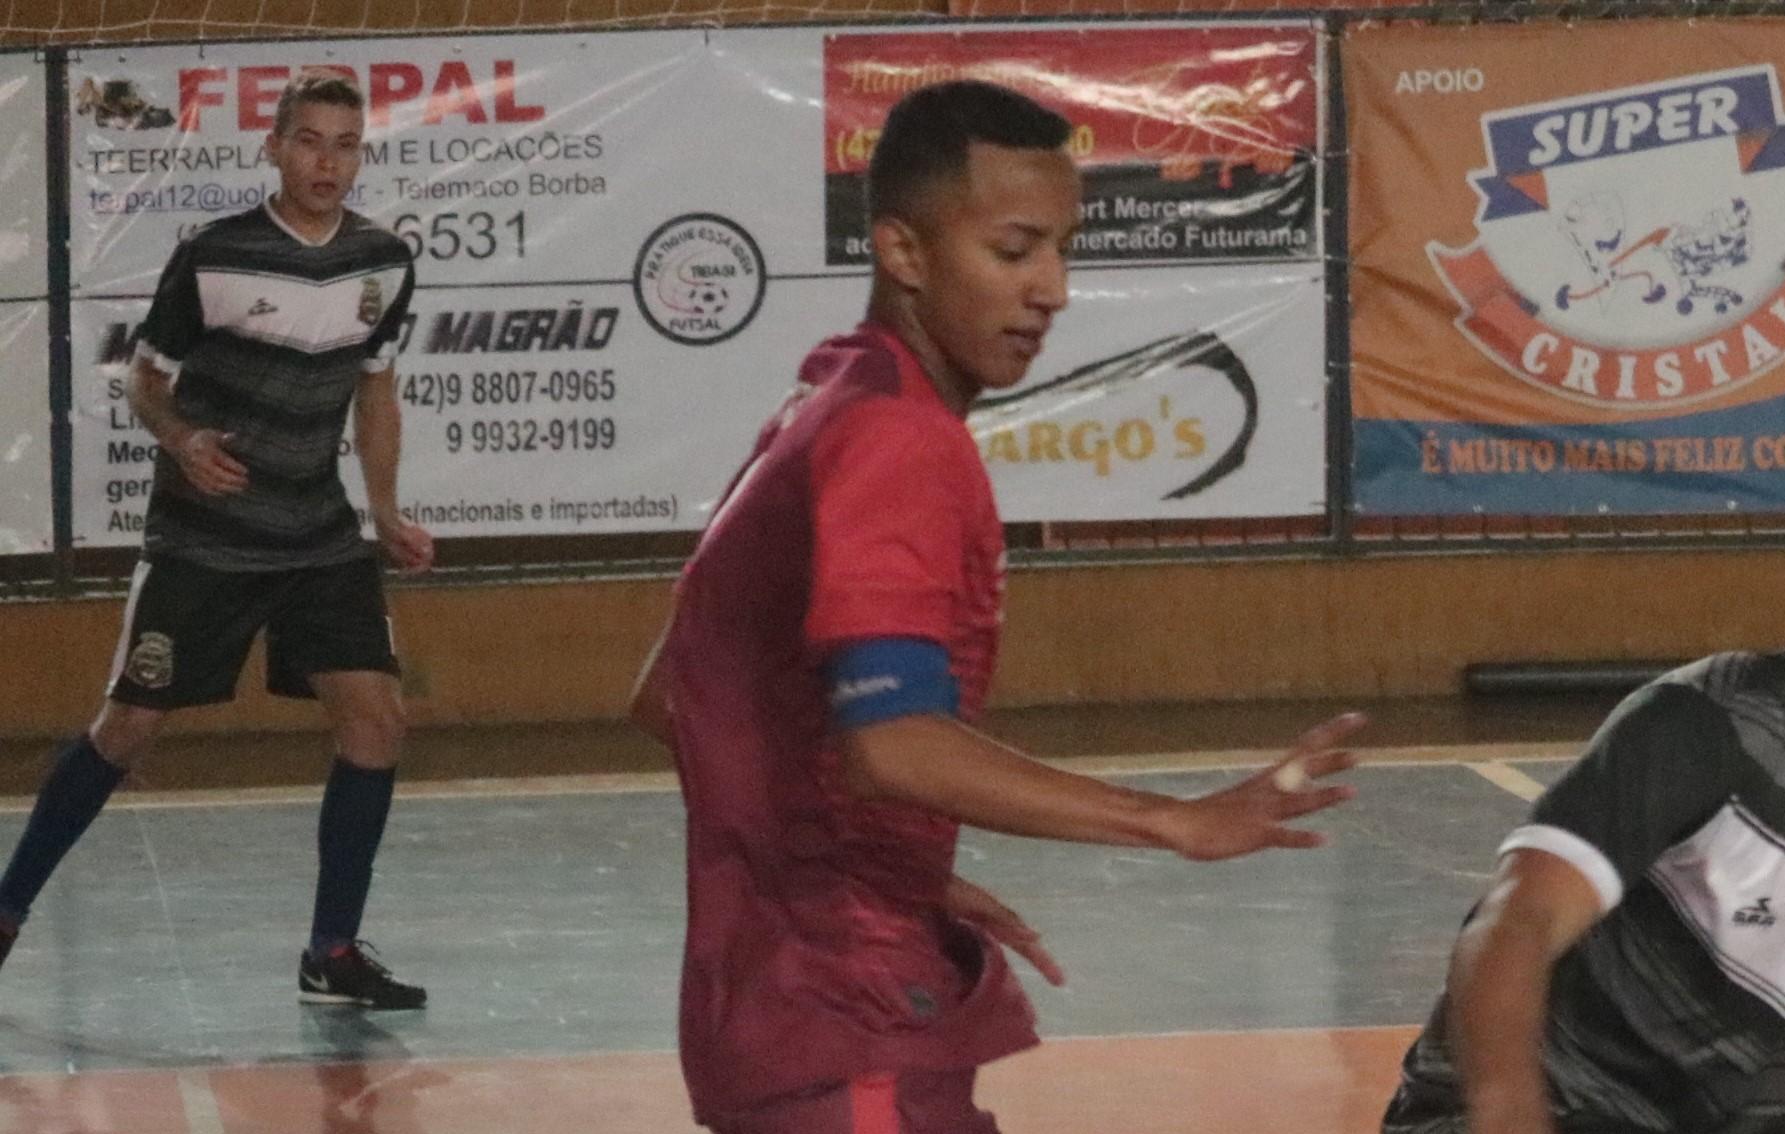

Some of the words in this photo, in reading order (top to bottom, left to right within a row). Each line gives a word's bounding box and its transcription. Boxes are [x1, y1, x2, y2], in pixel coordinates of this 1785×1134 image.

[1395, 69, 1485, 94] APOIO
[1528, 86, 1741, 166] SUPER
[400, 139, 419, 164] E
[528, 172, 607, 197] Borba
[1184, 226, 1308, 249] Futurama
[472, 368, 616, 406] 8807-0965
[446, 422, 463, 453] 9
[472, 417, 616, 453] 9932-9199
[1421, 430, 1441, 474] É
[1449, 437, 1555, 474] MUITO
[1563, 436, 1647, 472] MAIS
[1653, 435, 1745, 472] FELIZ
[530, 504, 543, 521] e
[550, 495, 679, 531] importadas)
